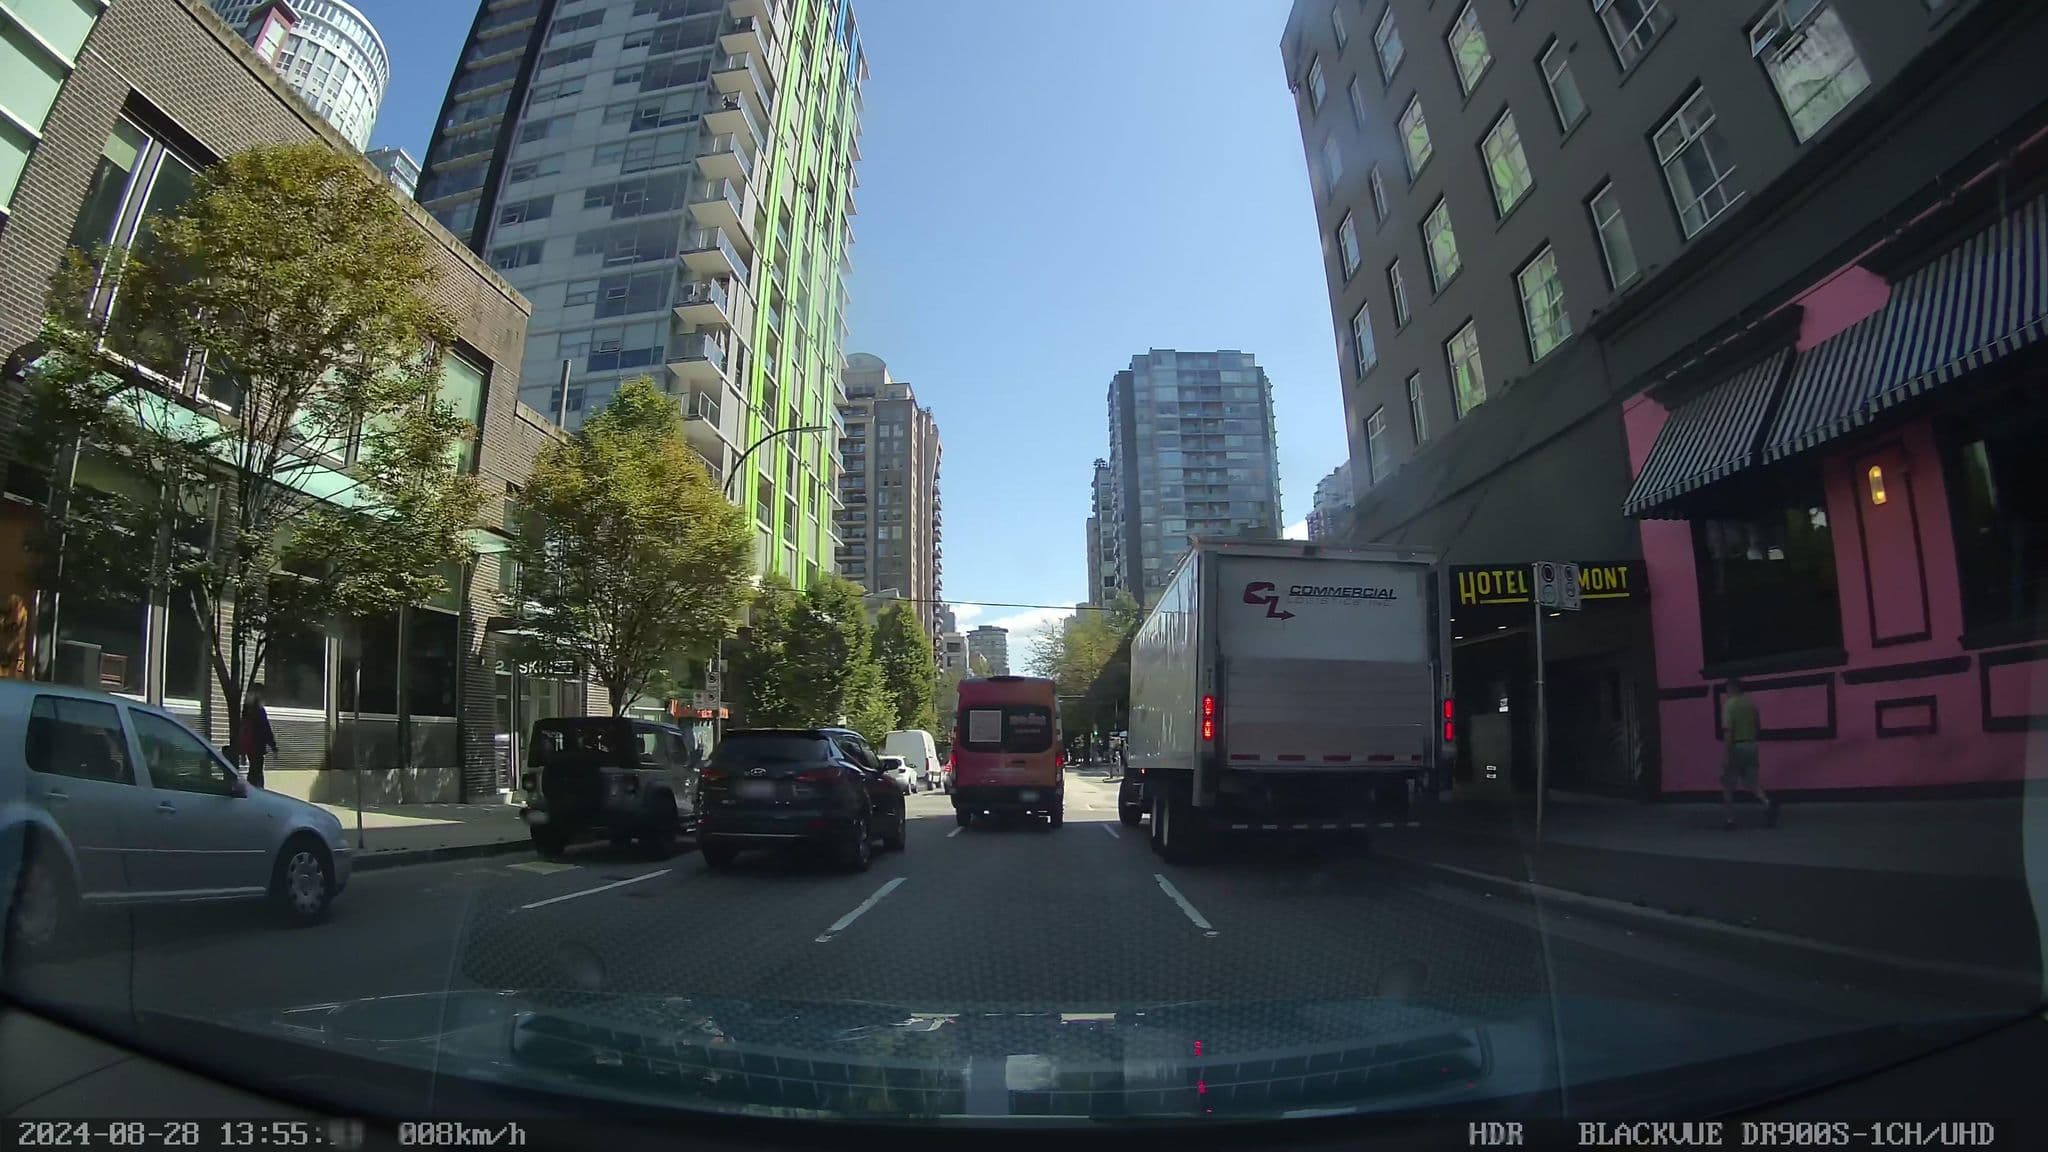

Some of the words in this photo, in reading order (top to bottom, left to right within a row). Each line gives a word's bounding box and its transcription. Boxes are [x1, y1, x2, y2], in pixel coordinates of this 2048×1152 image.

[1289, 585, 1398, 600] COMMERCIAL
[1458, 570, 1529, 605] HOTEL
[1577, 566, 1629, 591] MONT
